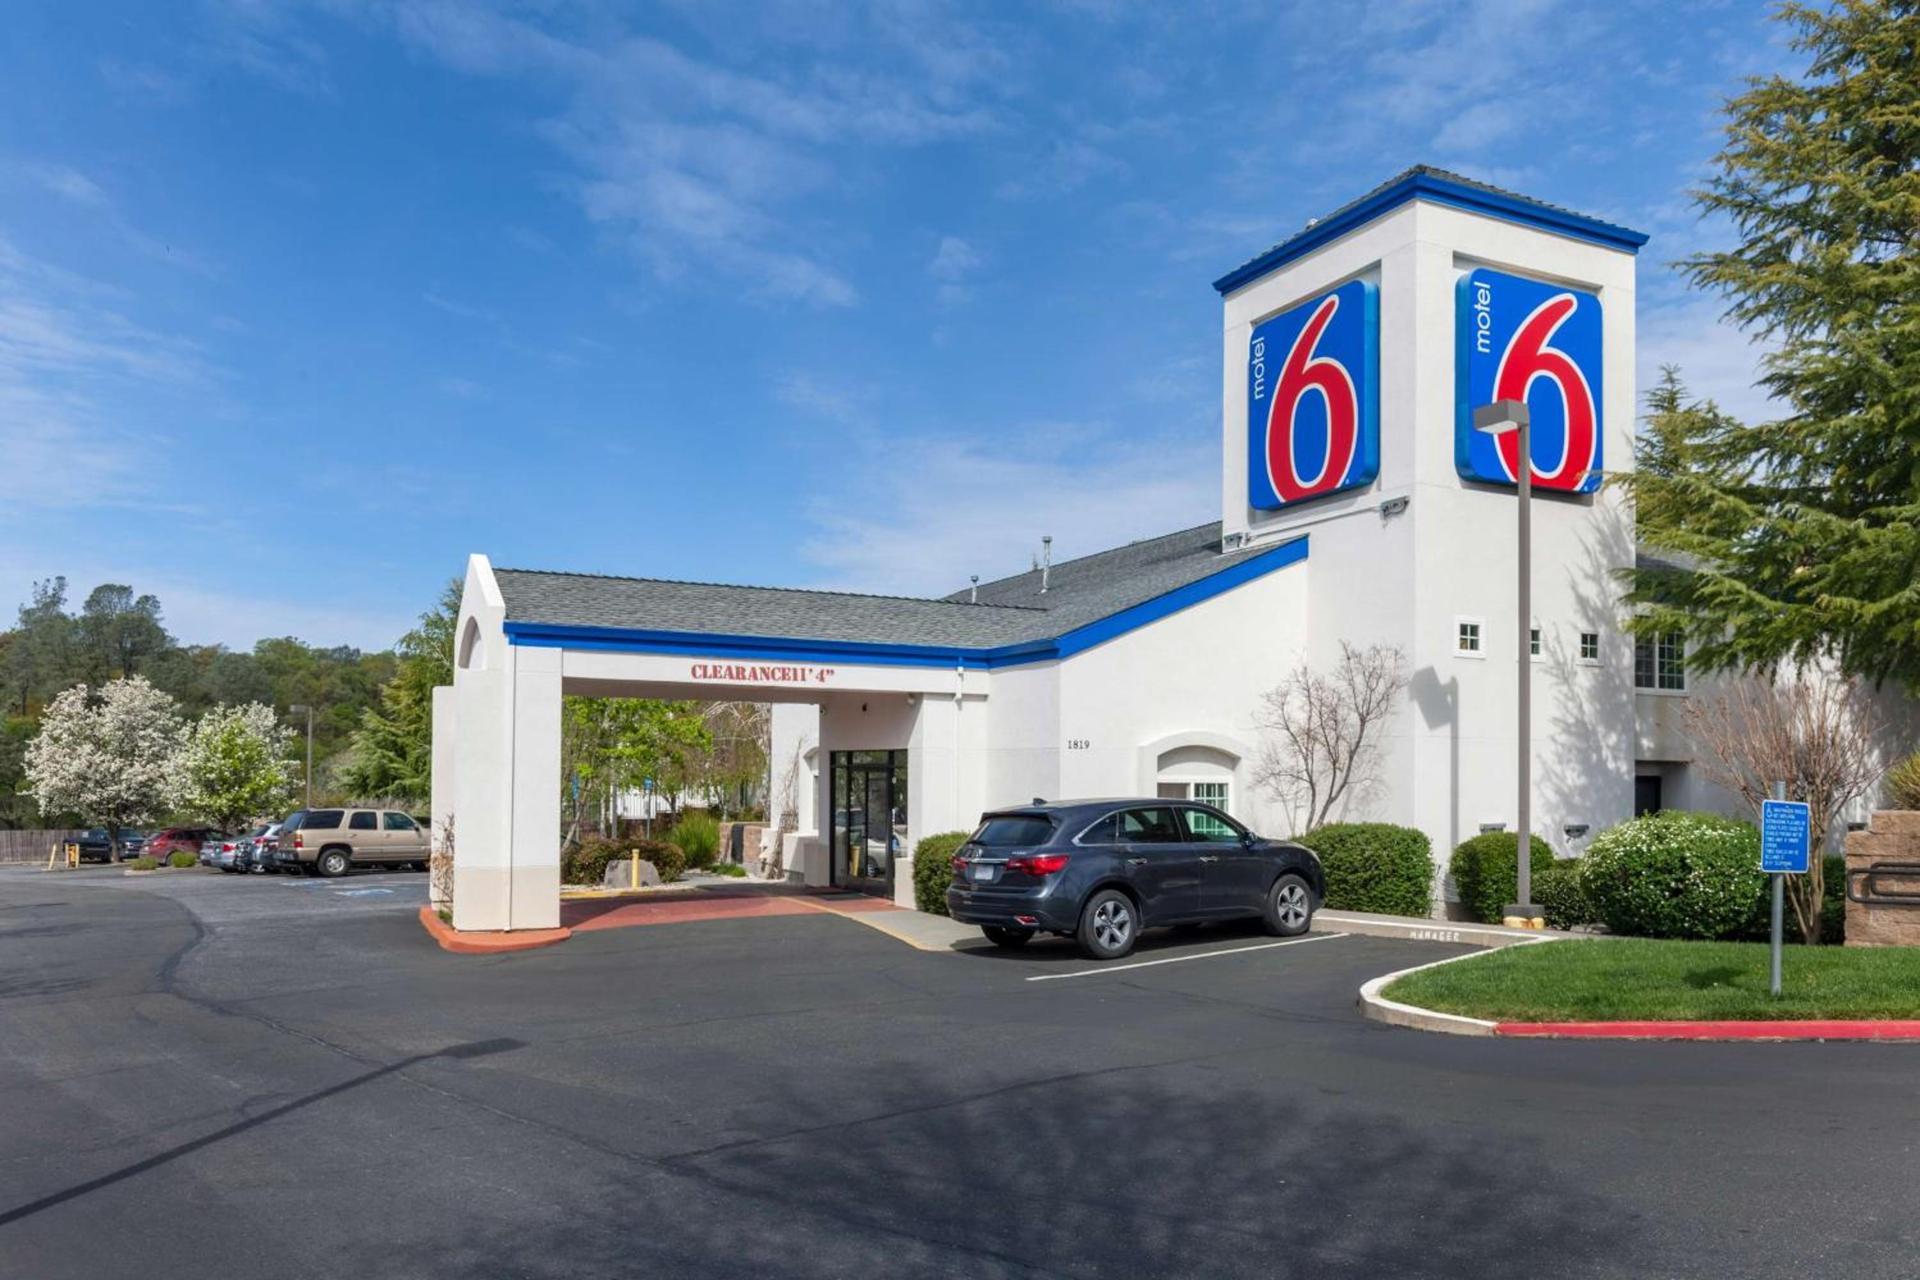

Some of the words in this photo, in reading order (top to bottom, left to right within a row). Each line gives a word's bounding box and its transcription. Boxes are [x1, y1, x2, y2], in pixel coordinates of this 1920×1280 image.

[1474, 281, 1491, 353] motel
[1252, 336, 1265, 400] motel
[1265, 294, 1358, 503] 6
[1492, 293, 1597, 492] 6
[1067, 739, 1090, 750] 1819
